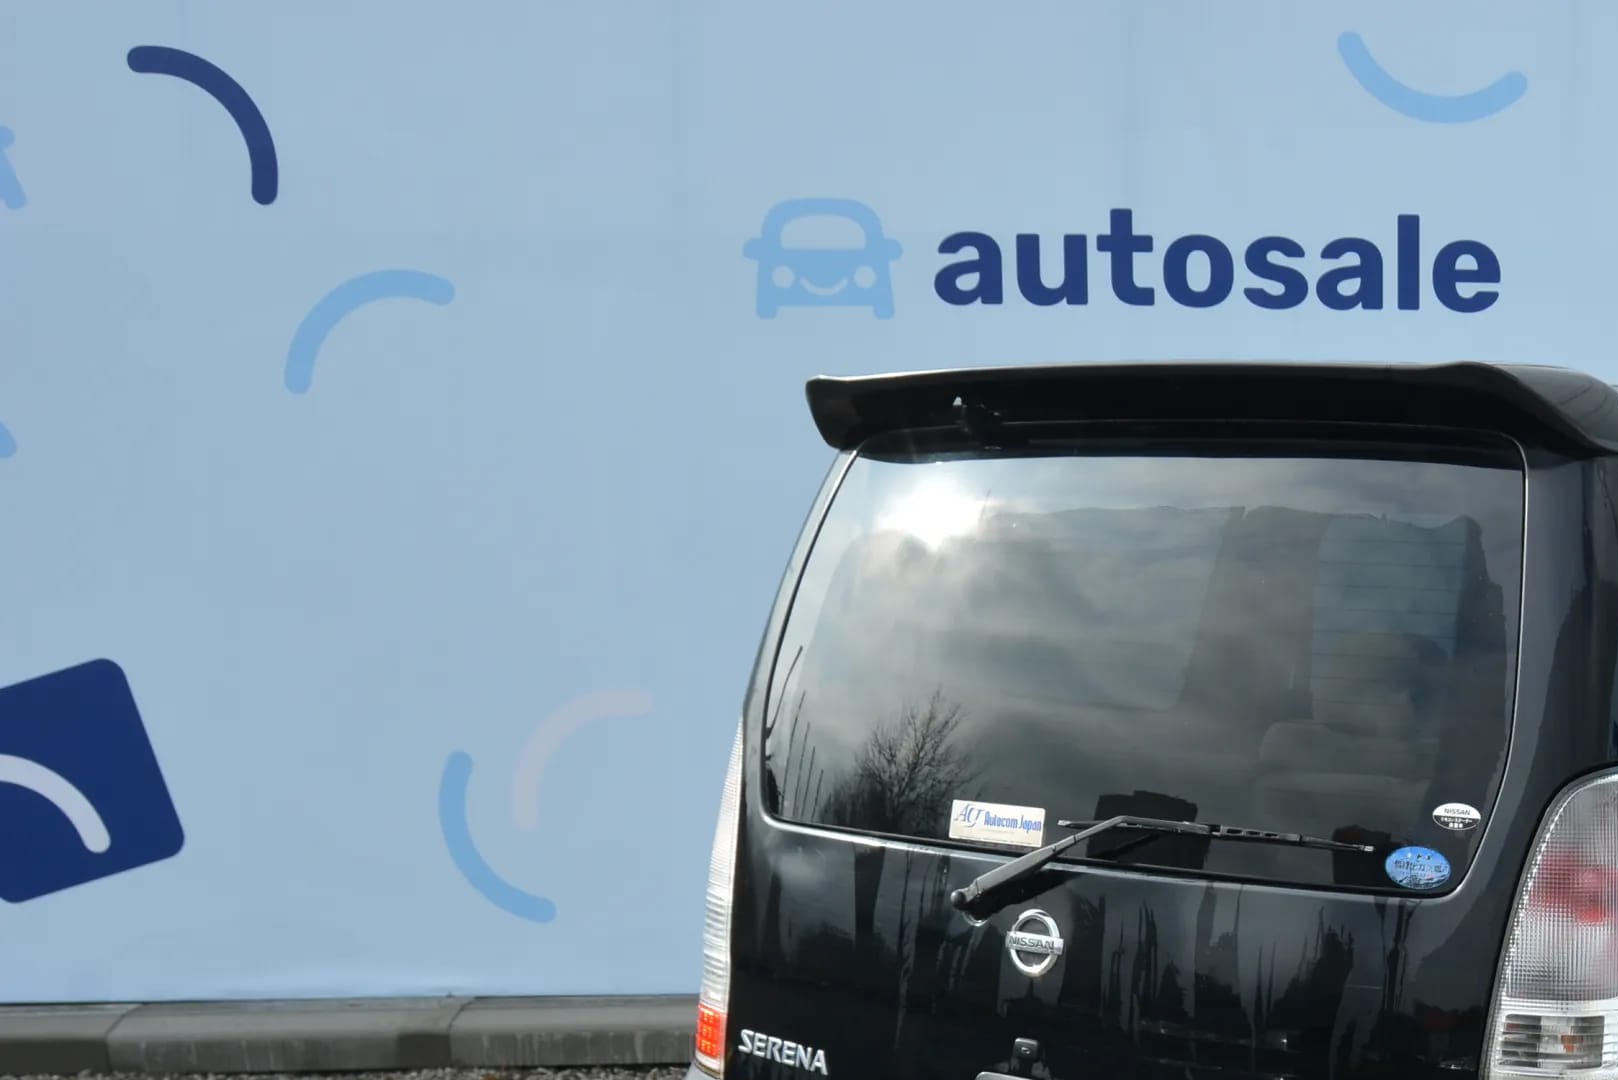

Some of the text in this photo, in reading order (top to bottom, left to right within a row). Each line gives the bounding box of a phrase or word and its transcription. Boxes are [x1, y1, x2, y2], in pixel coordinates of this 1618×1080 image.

[933, 208, 1502, 313] autosale
[1443, 807, 1471, 816] NISSAN
[1018, 814, 1042, 834] Japan
[1008, 935, 1055, 950] NISSAN
[738, 1029, 829, 1076] SERENA
